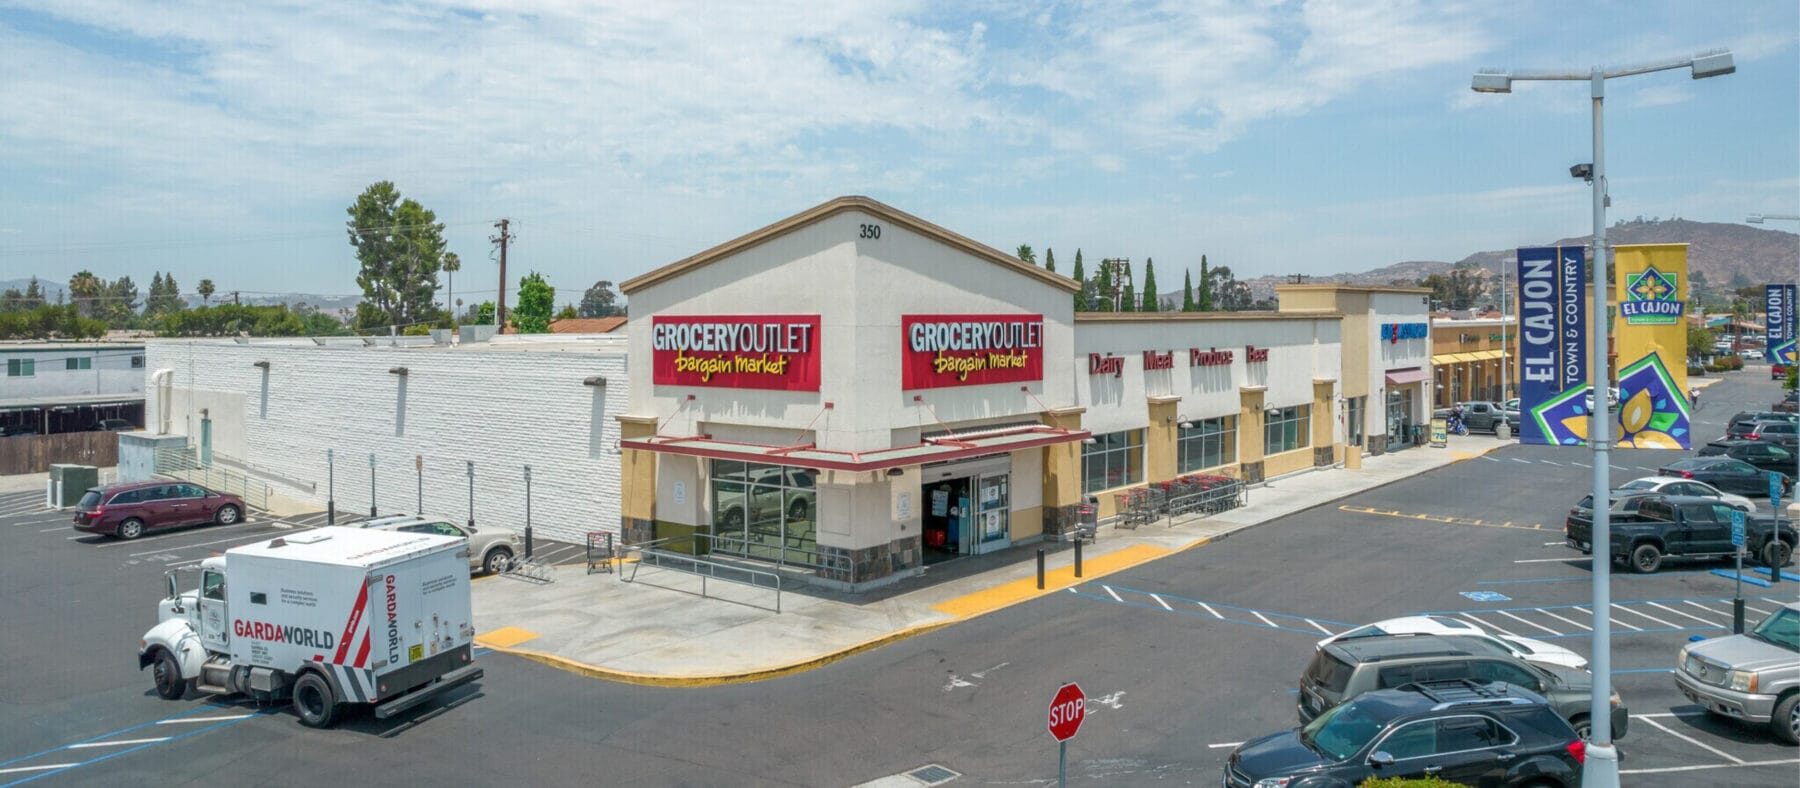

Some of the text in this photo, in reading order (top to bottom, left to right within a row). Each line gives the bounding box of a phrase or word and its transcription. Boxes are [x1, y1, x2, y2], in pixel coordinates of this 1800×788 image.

[860, 224, 881, 239] 350
[1523, 259, 1554, 382] EL CAJON
[1565, 257, 1579, 384] TOWN & COUNTRY
[1623, 301, 1680, 315] EL CAJON
[1768, 289, 1782, 338] EL CAJON
[675, 346, 786, 382] bargain market
[934, 347, 1028, 381] bargain market
[1089, 345, 1269, 378] Dairy Meat Produce Beer
[234, 618, 334, 649] GARDAWORLD
[386, 575, 399, 664] GARDAWORLD
[1050, 698, 1084, 727] STOP
